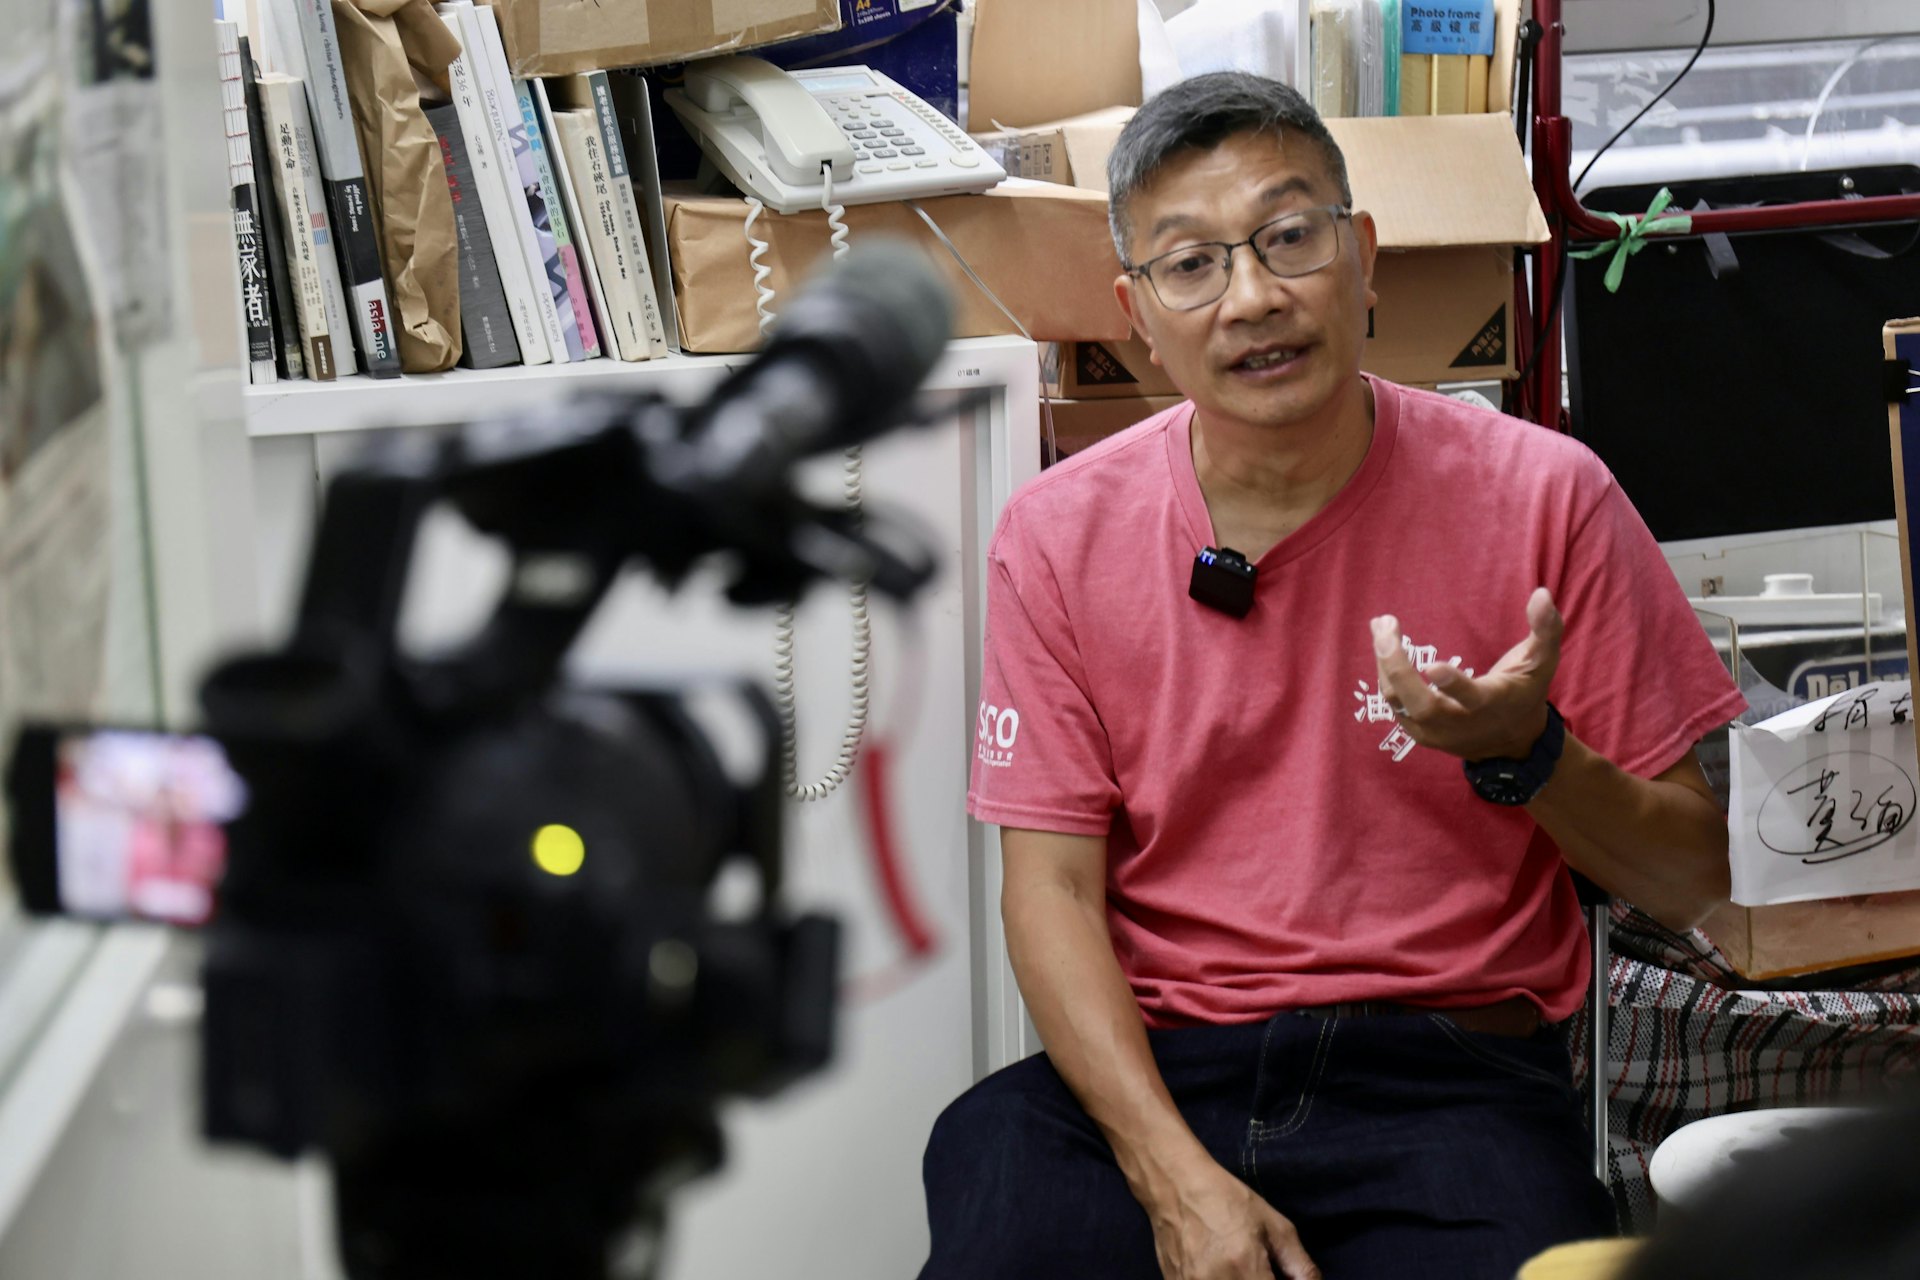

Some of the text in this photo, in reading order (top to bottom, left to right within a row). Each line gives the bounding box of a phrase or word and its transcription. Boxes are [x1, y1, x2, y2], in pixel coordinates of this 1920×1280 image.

[856, 0, 871, 11] A4
[1410, 7, 1481, 19] Photo frame
[326, 63, 344, 120] photographers
[234, 209, 263, 321] 無家者
[368, 300, 387, 360] asiaone
